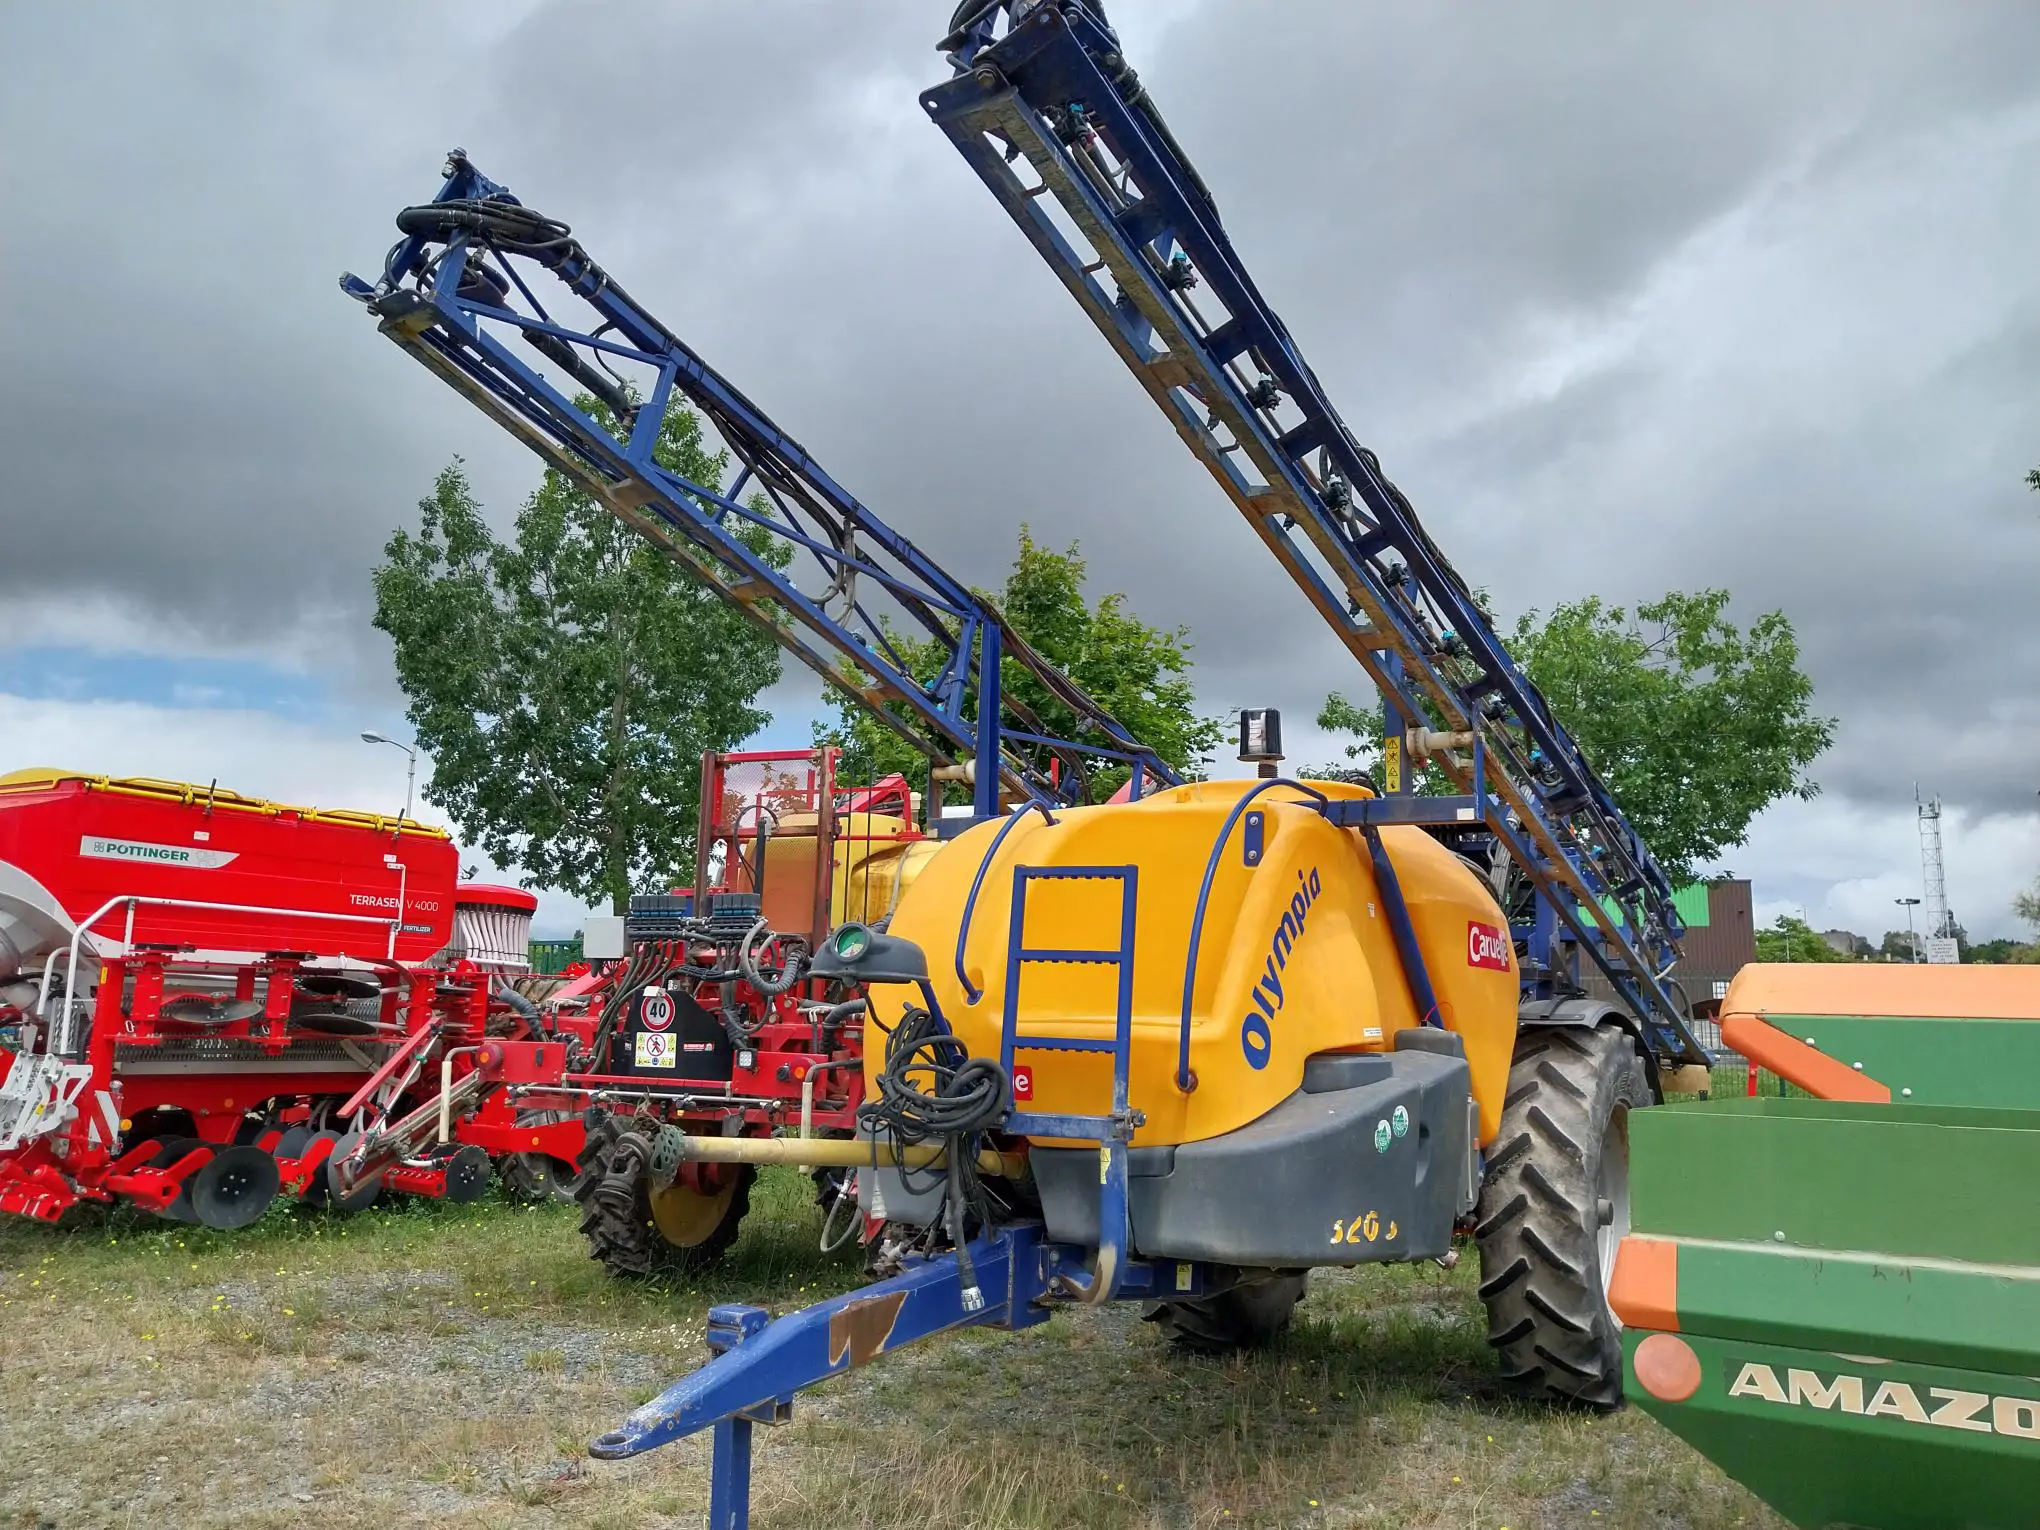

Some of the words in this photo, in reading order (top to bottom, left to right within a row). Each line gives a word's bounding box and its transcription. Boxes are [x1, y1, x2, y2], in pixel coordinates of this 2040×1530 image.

[406, 899, 414, 909] V
[403, 925, 431, 933] FERTILIZER
[1242, 866, 1322, 1070] Olympia
[649, 1002, 667, 1018] 40
